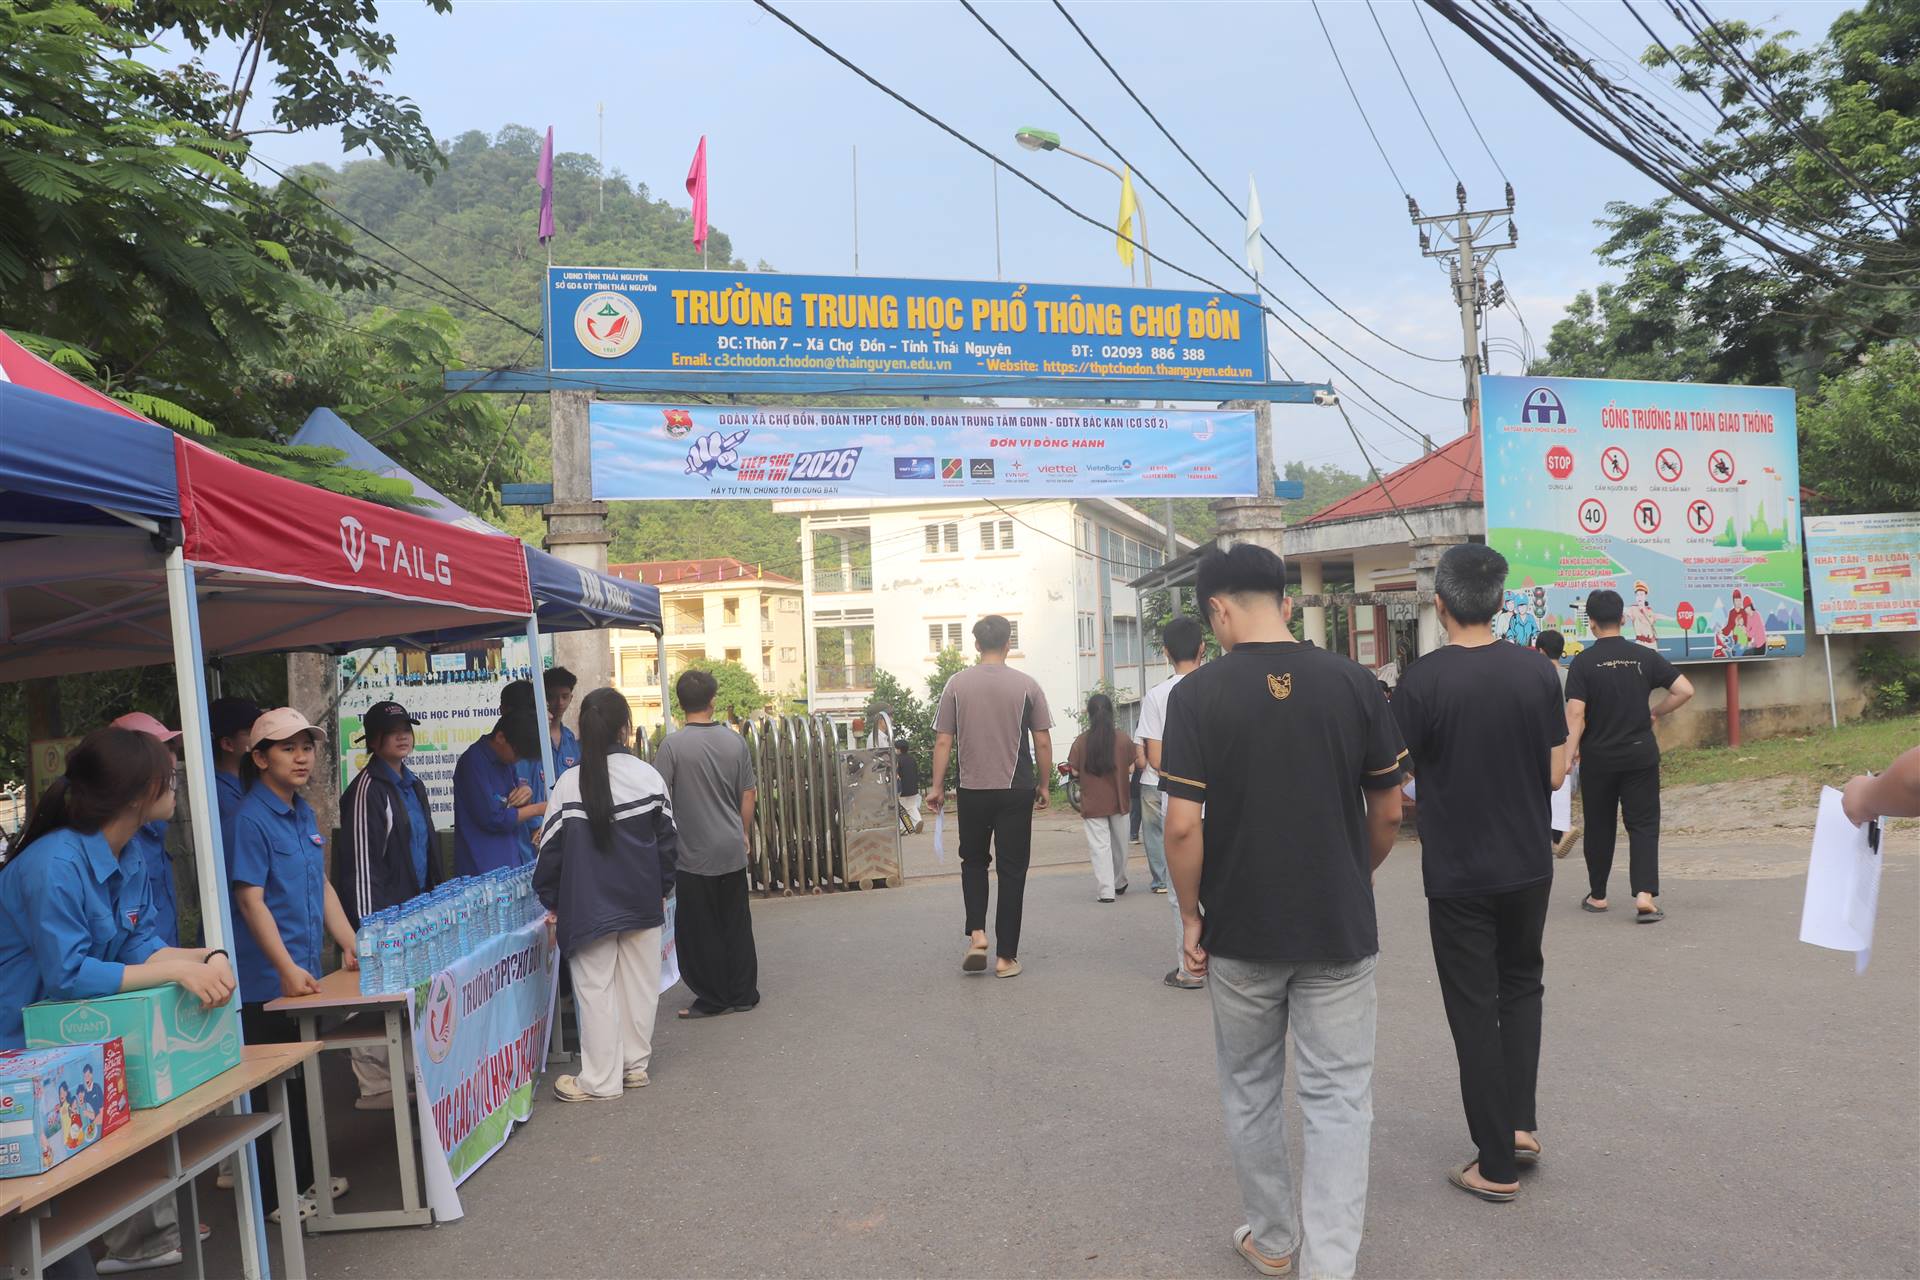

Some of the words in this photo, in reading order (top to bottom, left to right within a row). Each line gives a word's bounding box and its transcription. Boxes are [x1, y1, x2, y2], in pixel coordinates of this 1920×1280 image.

[672, 282, 792, 326] TRƯỜNG
[801, 293, 899, 329] TRUNG
[906, 296, 964, 337] HỌC
[972, 284, 1028, 332] PHỔ
[1034, 294, 1123, 336] THÔNG
[1130, 303, 1181, 344] CHỢ
[1187, 297, 1240, 340] ĐỒN
[744, 336, 776, 351] Thôn
[779, 337, 788, 350] 7
[806, 338, 824, 351] Xã
[829, 338, 854, 355] Chợ
[860, 337, 886, 352] Đồn
[901, 339, 928, 354] Tỉnh
[933, 341, 958, 354] Thái
[965, 342, 1012, 358] Nguyên
[1072, 345, 1093, 357] ĐT:
[1102, 346, 1143, 359] 02093
[1152, 348, 1175, 360] 886
[1183, 348, 1206, 361] 388
[672, 352, 712, 366] Email:
[714, 354, 952, 372] c3chodon.chodon@thainguyen.edu.vn
[986, 359, 1038, 372] Website:
[719, 413, 748, 425] ĐOÀN
[752, 413, 764, 425] XÃ
[768, 414, 790, 428] CHỢ
[821, 413, 850, 425] ĐOÀN
[853, 415, 878, 425] THPT
[881, 414, 901, 428] CHỢ
[931, 413, 958, 426] ĐOÀN
[962, 416, 994, 426] TRUNG
[996, 414, 1017, 426] TÂM
[1020, 417, 1047, 427] GDNN
[1056, 417, 1080, 427] GDTX
[1160, 418, 1168, 429] 2)
[1602, 400, 1629, 428] CỔNG
[1632, 406, 1670, 430] TRƯỜNG
[1674, 411, 1688, 430] AN
[1690, 408, 1715, 431] TOÀN
[1718, 413, 1740, 432] GIAO
[1743, 410, 1773, 433] THÔNG
[990, 438, 1017, 448] ĐƠN
[1020, 439, 1031, 449] VỊ
[1034, 436, 1068, 448] ĐỒNG
[1072, 437, 1105, 448] HÀNH
[791, 449, 858, 478] 2026
[1038, 465, 1078, 473] viettel
[1549, 456, 1571, 470] STOP
[1585, 508, 1600, 524] 40
[371, 533, 452, 586] TAILG
[430, 711, 449, 721] HỌC
[452, 707, 470, 718] PHỔ
[462, 968, 493, 1017] TRƯỜNG
[65, 1020, 106, 1034] VIVANT
